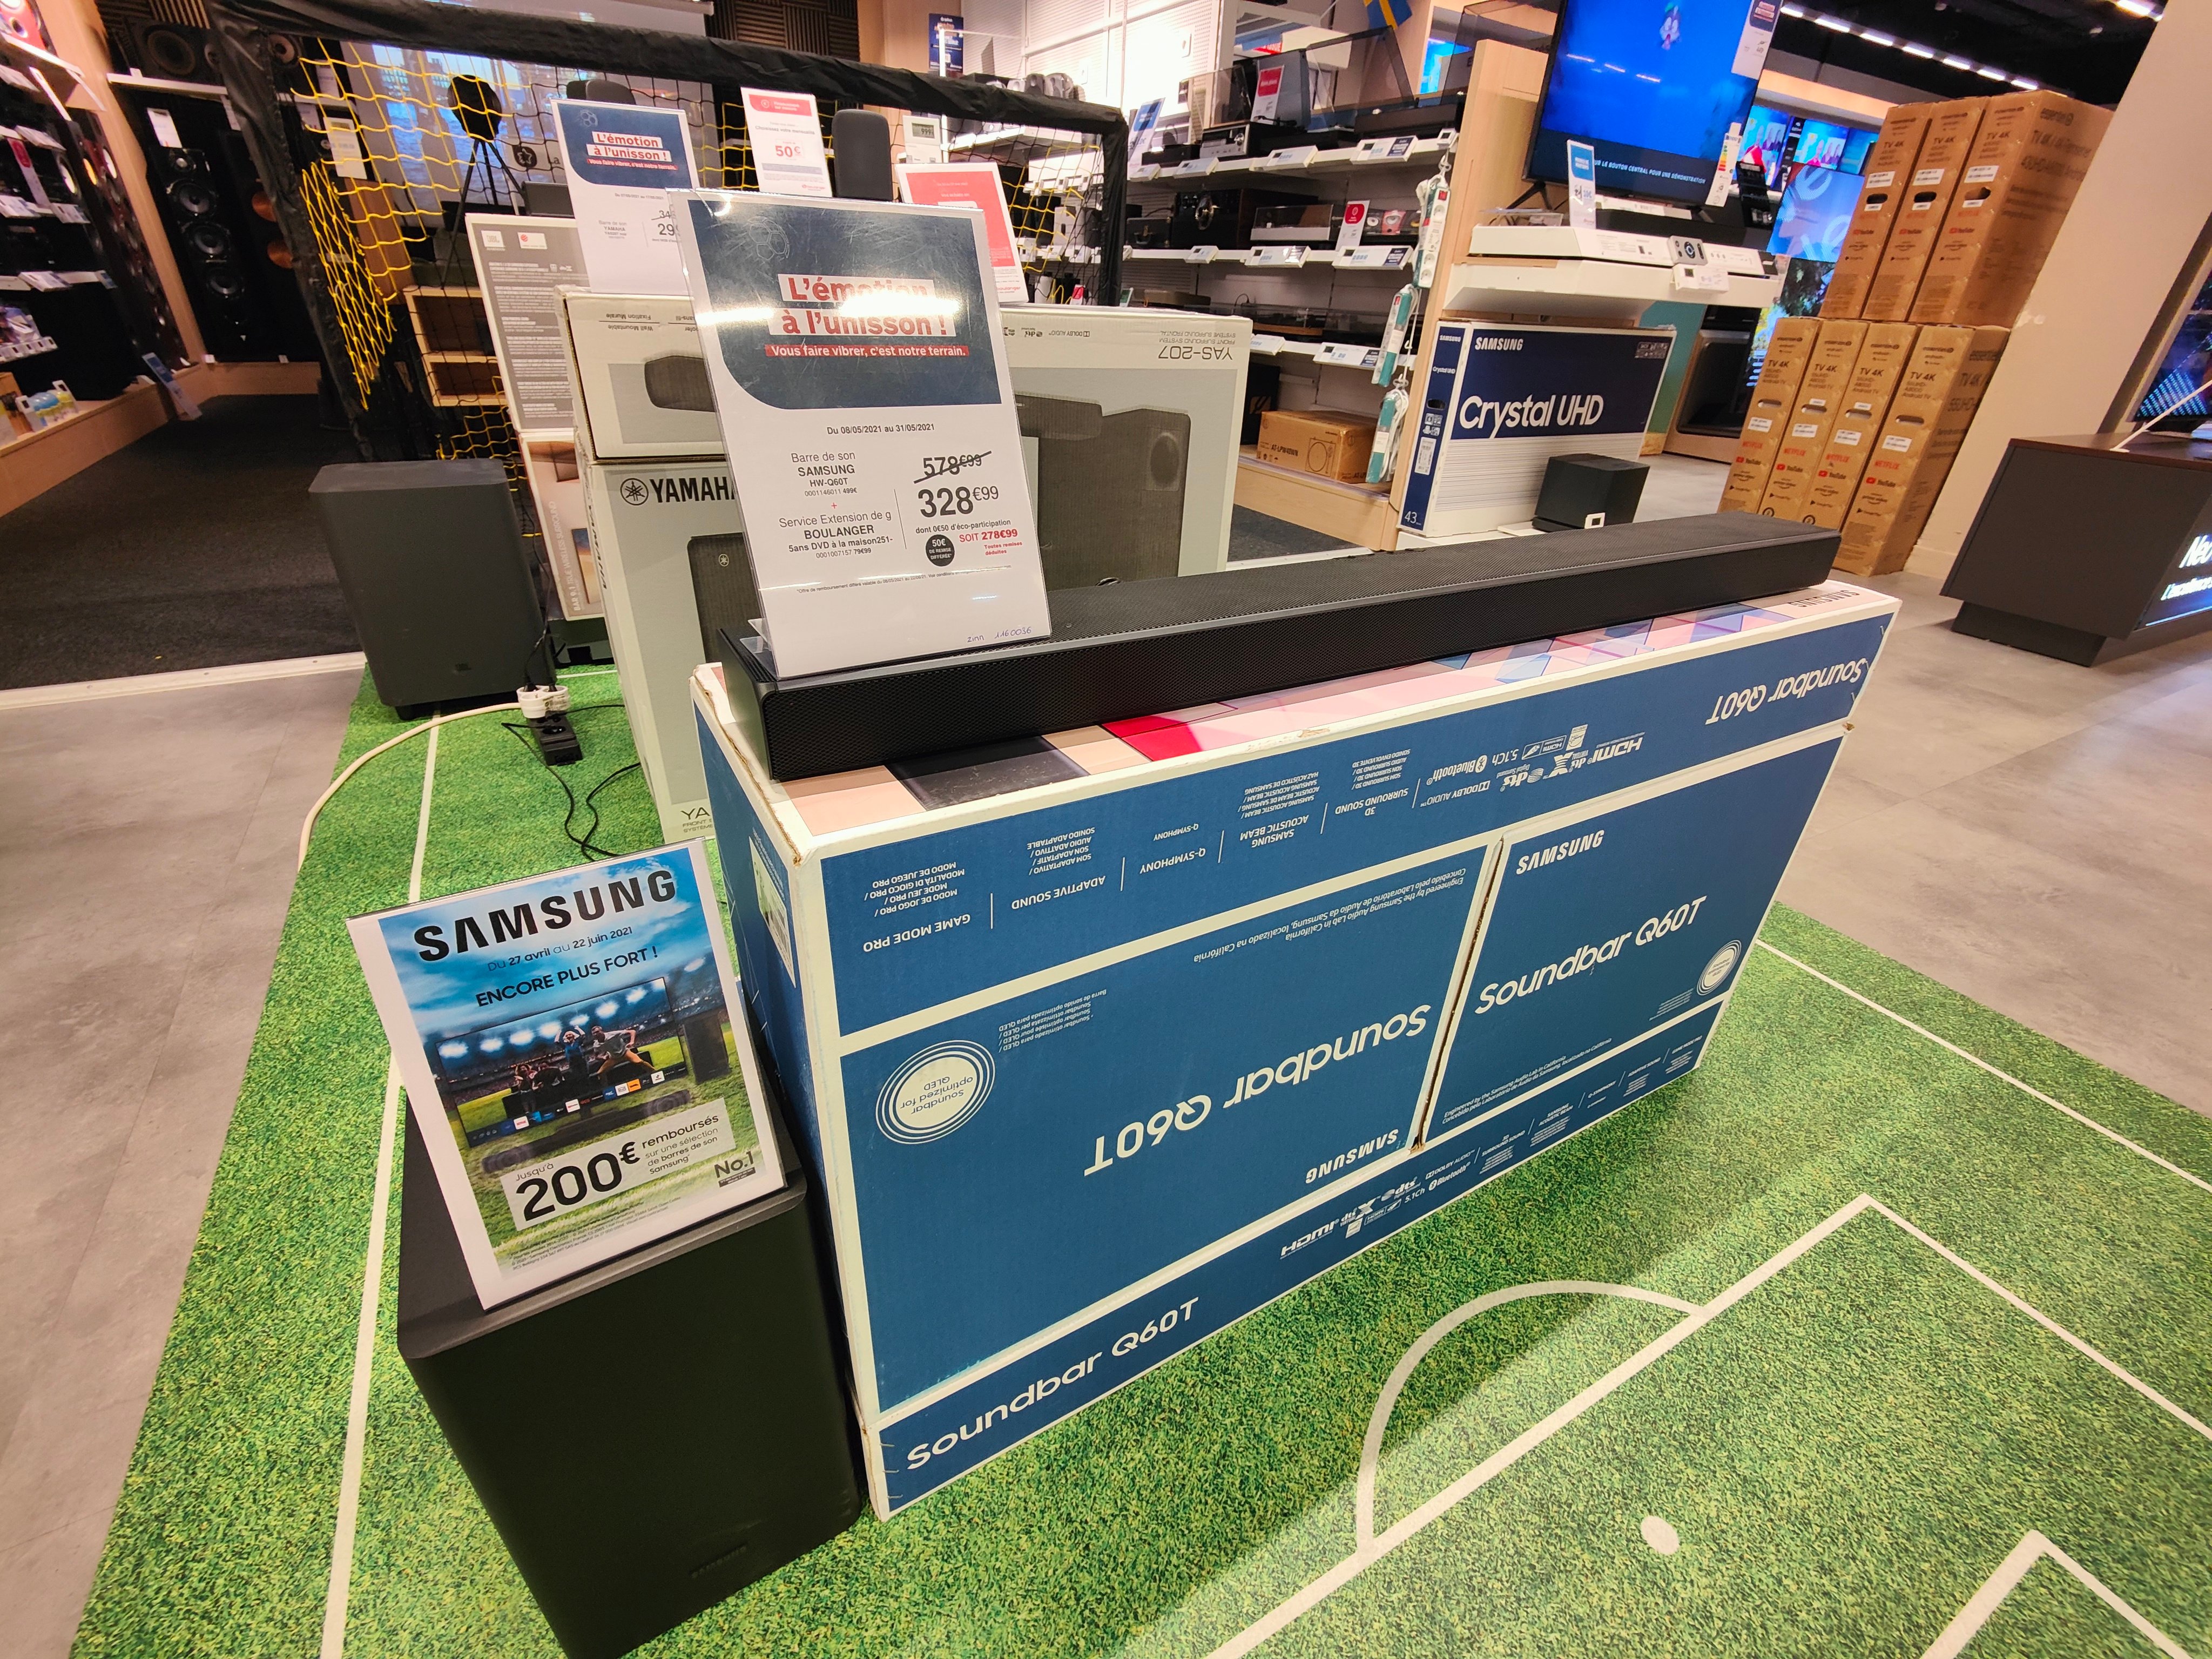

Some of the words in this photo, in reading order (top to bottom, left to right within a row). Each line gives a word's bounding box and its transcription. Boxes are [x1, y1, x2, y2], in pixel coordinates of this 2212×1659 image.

[597, 133, 659, 147] L'émotion
[594, 146, 601, 156] à
[605, 146, 660, 160] l'unisson
[782, 309, 800, 334] à
[807, 310, 933, 335] l'unisson
[941, 315, 947, 335] !
[772, 346, 802, 356] Vous
[804, 345, 830, 356] faire
[832, 346, 868, 358] vibrer,
[870, 346, 895, 356] c'est
[898, 346, 927, 356] notre
[929, 346, 966, 356] terrain.
[1475, 336, 1524, 351] SAMSUNG
[1158, 346, 1233, 360] YAS-207
[1459, 393, 1556, 439] Crystal
[1557, 394, 1604, 426] UHD
[827, 426, 839, 435] Du
[840, 425, 882, 434] 08/05/2021
[895, 423, 935, 433] 31/05/2021
[791, 453, 820, 463] Barre
[822, 451, 835, 462] de
[838, 451, 856, 461] son
[798, 464, 855, 477] SAMSUNG
[649, 476, 736, 503] YAMAH
[810, 477, 848, 488] HW-Q60T
[805, 488, 842, 497] 0001146011
[842, 487, 858, 495] 499€
[918, 485, 999, 518] 328€99
[779, 516, 818, 528] Service
[820, 512, 868, 525] Extension
[871, 511, 883, 521] de
[885, 511, 892, 521] g
[1405, 511, 1417, 523] 43
[804, 524, 874, 539] BOULANGER
[915, 526, 932, 534] dont
[951, 520, 1011, 531] d'éco-participation
[959, 533, 979, 542] SOIT
[982, 529, 1017, 540] 278€99
[788, 543, 809, 554] 5ans
[811, 541, 829, 551] DVD
[832, 539, 838, 549] à
[840, 538, 846, 548] la
[932, 538, 946, 547] 50€
[815, 549, 853, 558] 0001007157
[854, 547, 872, 555] 79€99
[1766, 658, 1866, 704] Soundbar
[1705, 684, 1766, 726] Q60T
[1492, 748, 1519, 766] 5.1Ch
[1365, 788, 1410, 808] SURROUND
[1451, 782, 1479, 798] DOLBY
[1334, 801, 1363, 815] SOUND
[1365, 806, 1377, 817] 3D
[1154, 823, 1199, 841] Q-SYMPHONY
[1239, 825, 1266, 841] BEAM
[1267, 814, 1310, 834] ACOUSTIC
[1251, 829, 1295, 848] SAMSUNG
[1139, 847, 1206, 874] Q-SYMPHONY
[1516, 830, 1605, 875] SAMSUNG
[1055, 875, 1106, 897] ADAPTIVE
[1414, 887, 1425, 899] by
[1425, 876, 1464, 896] Engineered
[1011, 891, 1052, 909] SOUND
[1370, 897, 1402, 915] Samsung
[1404, 892, 1414, 902] the
[413, 869, 676, 962] SAMSUNG
[935, 913, 970, 933] GAME
[1332, 914, 1346, 925] Lab
[1347, 907, 1368, 921] Audio
[894, 924, 932, 944] MODE
[1286, 923, 1322, 941] California
[1324, 921, 1330, 929] in
[488, 959, 506, 972] Du
[508, 956, 521, 967] 27
[524, 947, 551, 962] avril
[554, 943, 570, 954] au
[572, 938, 586, 949] 22
[588, 933, 608, 948] juin
[610, 926, 632, 938] 2021
[863, 935, 891, 952] PRO
[1475, 931, 1633, 1015] Soundbar
[1635, 895, 1707, 947] Q60T
[476, 974, 555, 1007] ENCORE
[558, 961, 600, 984] PLUS
[604, 948, 648, 972] FORT
[652, 946, 658, 958] !
[1223, 1004, 1432, 1109] Soundbar
[920, 1076, 974, 1102] optimized
[923, 1076, 950, 1091] QLED
[900, 1098, 918, 1109] for
[911, 1089, 964, 1115] Soundbar
[642, 1115, 719, 1149] remboursés
[1084, 1095, 1211, 1176] Q60T
[645, 1149, 659, 1159] sur
[661, 1142, 678, 1154] une
[679, 1127, 718, 1147] sélection
[648, 1156, 660, 1167] de
[661, 1146, 689, 1162] barres
[691, 1141, 702, 1152] de
[703, 1137, 718, 1146] son
[714, 1150, 754, 1178] No.1
[1305, 1129, 1399, 1184] SAMSUNG
[515, 1141, 641, 1221] 200€
[516, 1162, 554, 1182] Jusqu'à
[907, 1351, 1103, 1470] Soundbar
[1111, 1296, 1199, 1358] Q60T
